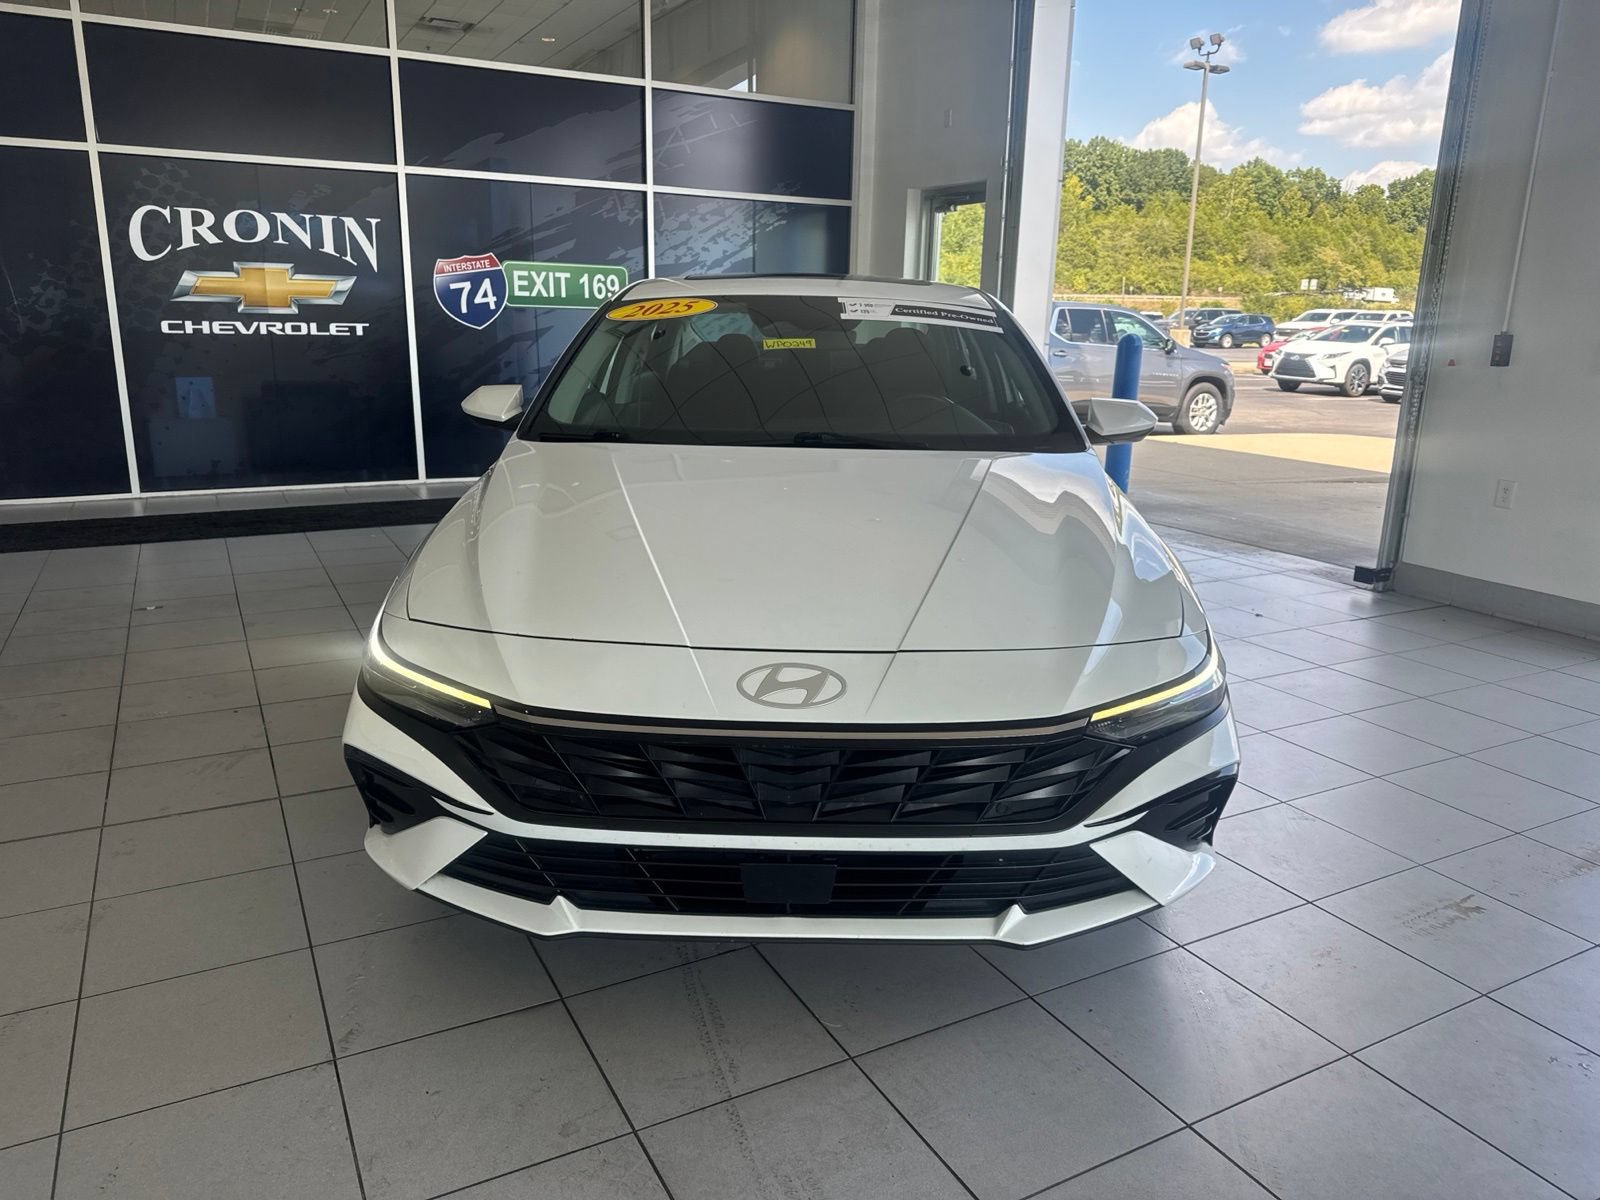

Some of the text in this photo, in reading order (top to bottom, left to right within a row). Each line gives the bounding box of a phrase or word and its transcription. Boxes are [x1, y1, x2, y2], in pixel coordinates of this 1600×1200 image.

[128, 204, 381, 273] CRONIN
[443, 259, 491, 272] INTERSTATE
[513, 270, 619, 299] EXIT 169
[449, 278, 497, 314] 74
[623, 300, 698, 318] 2025
[895, 307, 994, 323] Certified Pre-Owned
[160, 320, 370, 336] CHEVROLET
